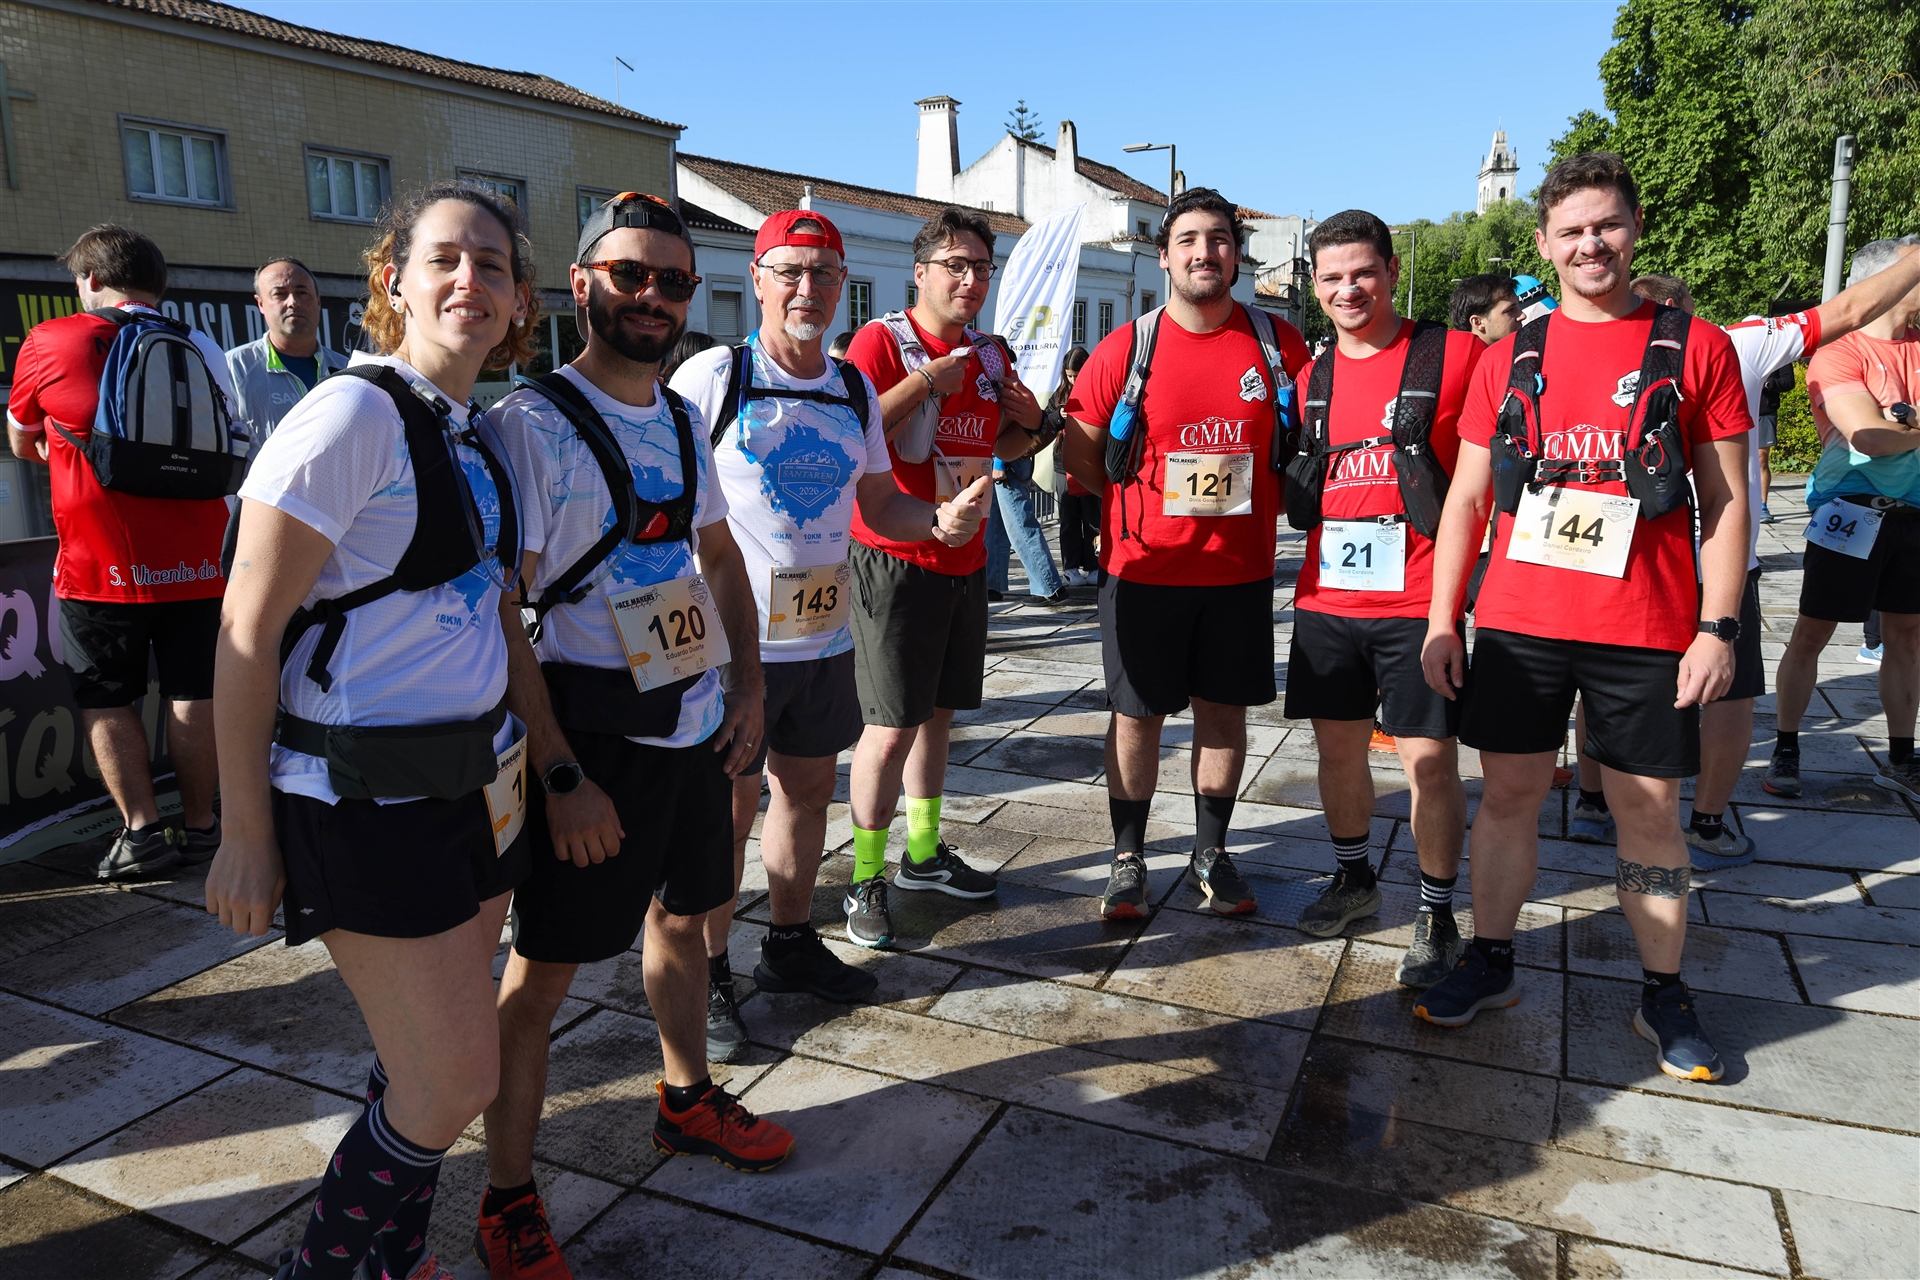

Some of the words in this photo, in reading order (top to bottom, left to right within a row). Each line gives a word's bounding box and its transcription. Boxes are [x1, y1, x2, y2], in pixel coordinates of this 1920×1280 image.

[160, 465, 189, 473] ADVENTURE
[783, 470, 834, 480] SANTARÉM
[799, 486, 820, 496] 2026
[1186, 472, 1232, 496] 121
[1540, 510, 1604, 547] 144
[1825, 514, 1858, 538] 94
[1342, 542, 1372, 568] 21
[1542, 541, 1563, 550] Daniel
[1563, 543, 1592, 555] Cordeiro
[109, 565, 126, 587] S.
[131, 563, 196, 586] Vicente
[792, 585, 838, 616] 143
[435, 613, 462, 626] 18KM
[647, 605, 706, 651] 120
[665, 649, 689, 661] Eduardo
[688, 643, 705, 653] Duarte
[772, 931, 802, 940] FILA
